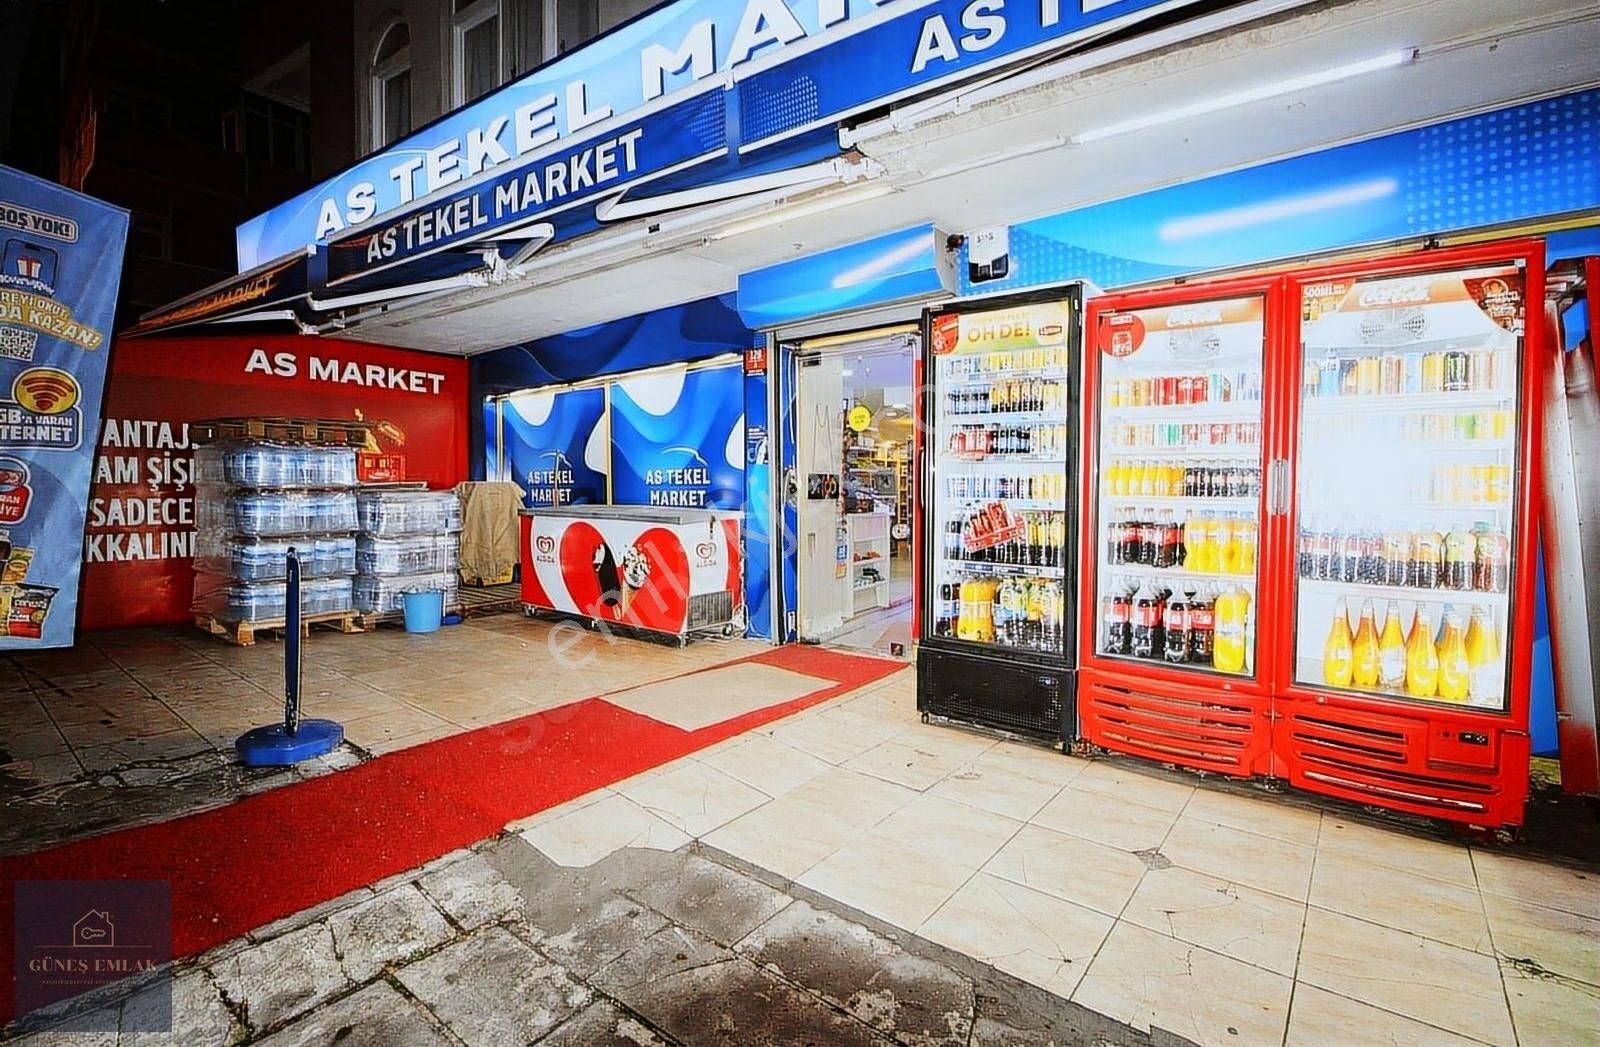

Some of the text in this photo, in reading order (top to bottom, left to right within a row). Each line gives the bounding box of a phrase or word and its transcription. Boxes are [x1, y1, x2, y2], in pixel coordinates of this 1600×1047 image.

[911, 0, 1007, 74] AS
[314, 181, 377, 241] AS
[390, 79, 614, 204] TEKEL
[367, 128, 643, 264] AS TEKEL MARKET
[31, 214, 71, 237] YOK!
[29, 310, 102, 347] KAZAN!
[967, 325, 995, 343] OH
[1000, 320, 1030, 338] DE!
[245, 349, 445, 395] AS MARKET
[542, 469, 575, 485] TEKEL
[645, 467, 711, 485] AS TEKEL
[89, 497, 193, 527] SADECE
[650, 489, 706, 506] MARKET
